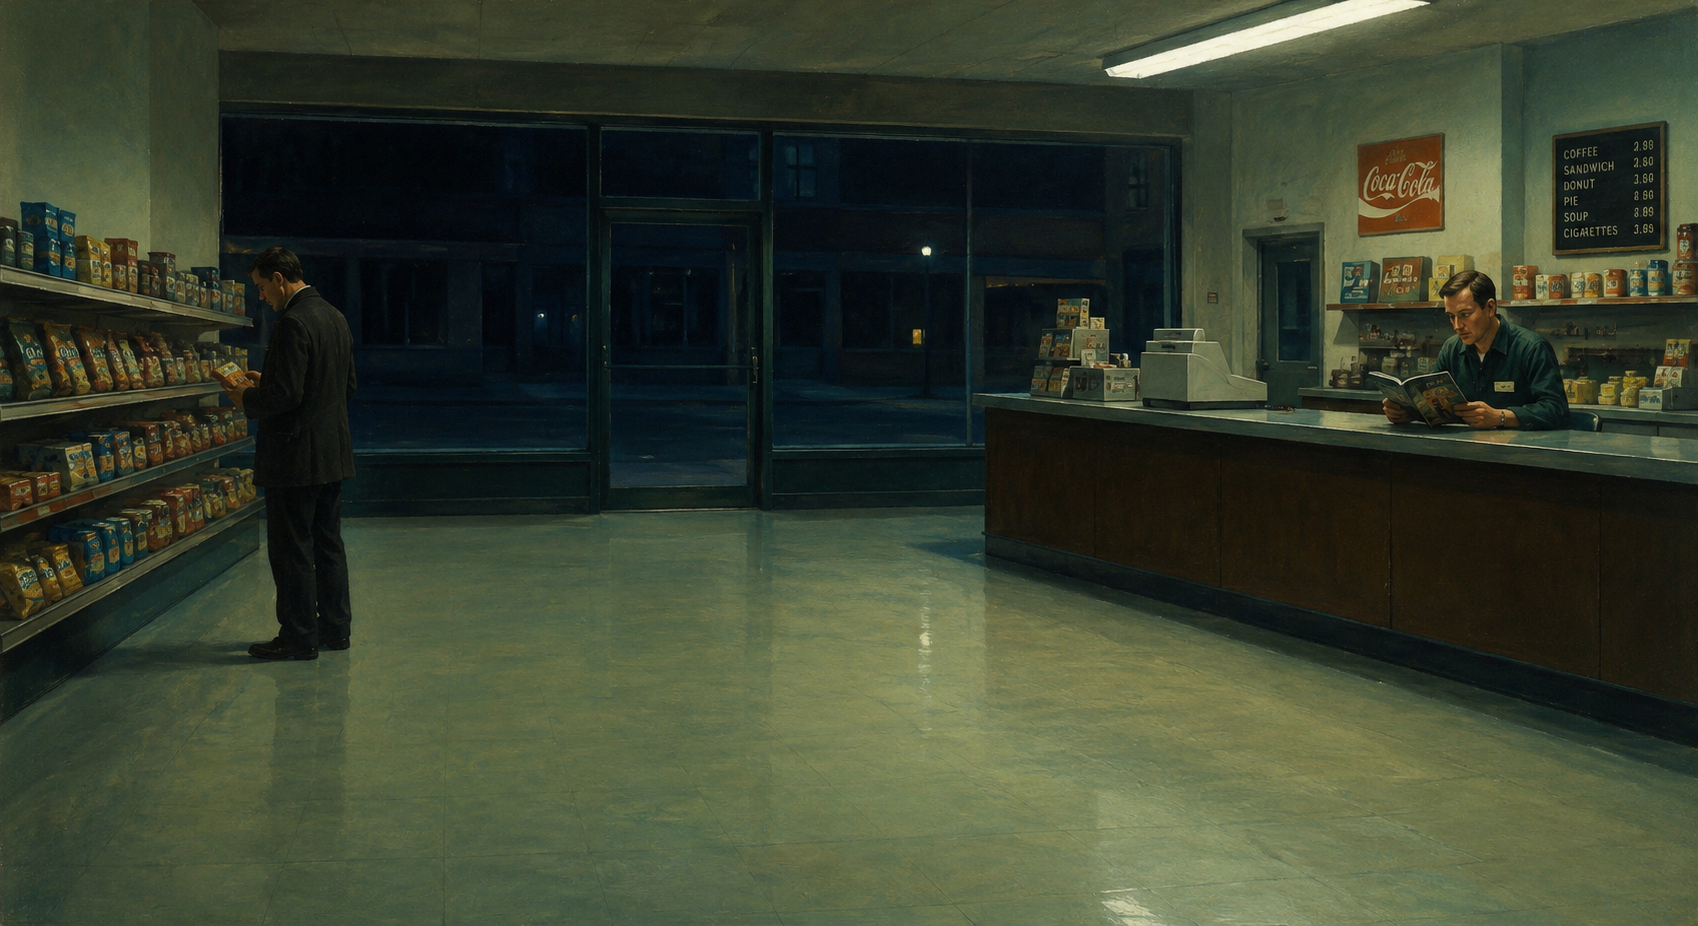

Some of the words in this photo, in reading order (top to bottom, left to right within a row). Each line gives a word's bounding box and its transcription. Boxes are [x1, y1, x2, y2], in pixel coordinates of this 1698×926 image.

[1564, 146, 1598, 160] COFFEE
[1564, 161, 1615, 176] SANDWICH
[1363, 160, 1438, 201] Coca-Cola
[1564, 179, 1596, 190] DONUT
[1564, 196, 1579, 206] PIE
[1564, 212, 1589, 222] SOUP
[1564, 225, 1618, 238] CIGARETTES
